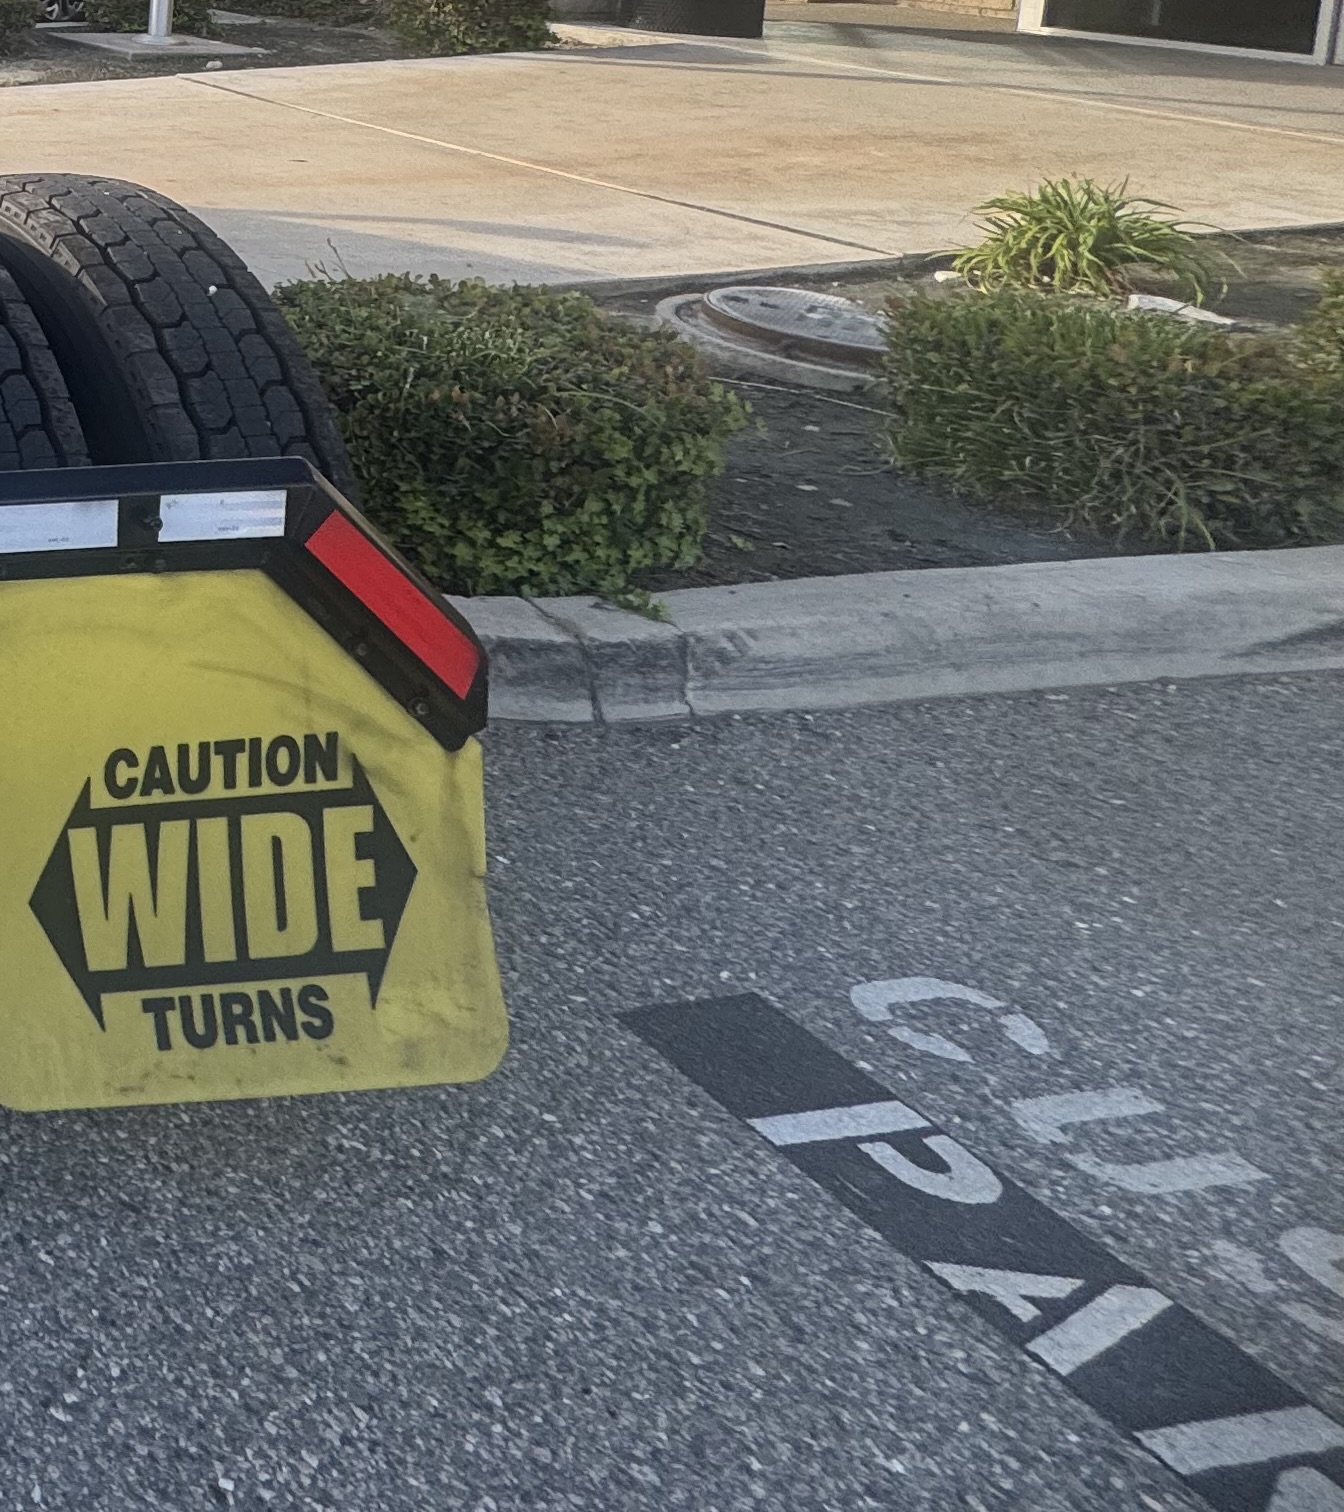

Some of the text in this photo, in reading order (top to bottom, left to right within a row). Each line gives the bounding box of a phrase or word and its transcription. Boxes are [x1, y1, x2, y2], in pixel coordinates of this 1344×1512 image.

[103, 731, 339, 800] CAUTION
[67, 804, 386, 972] WIDE
[142, 985, 335, 1052] TURNS
